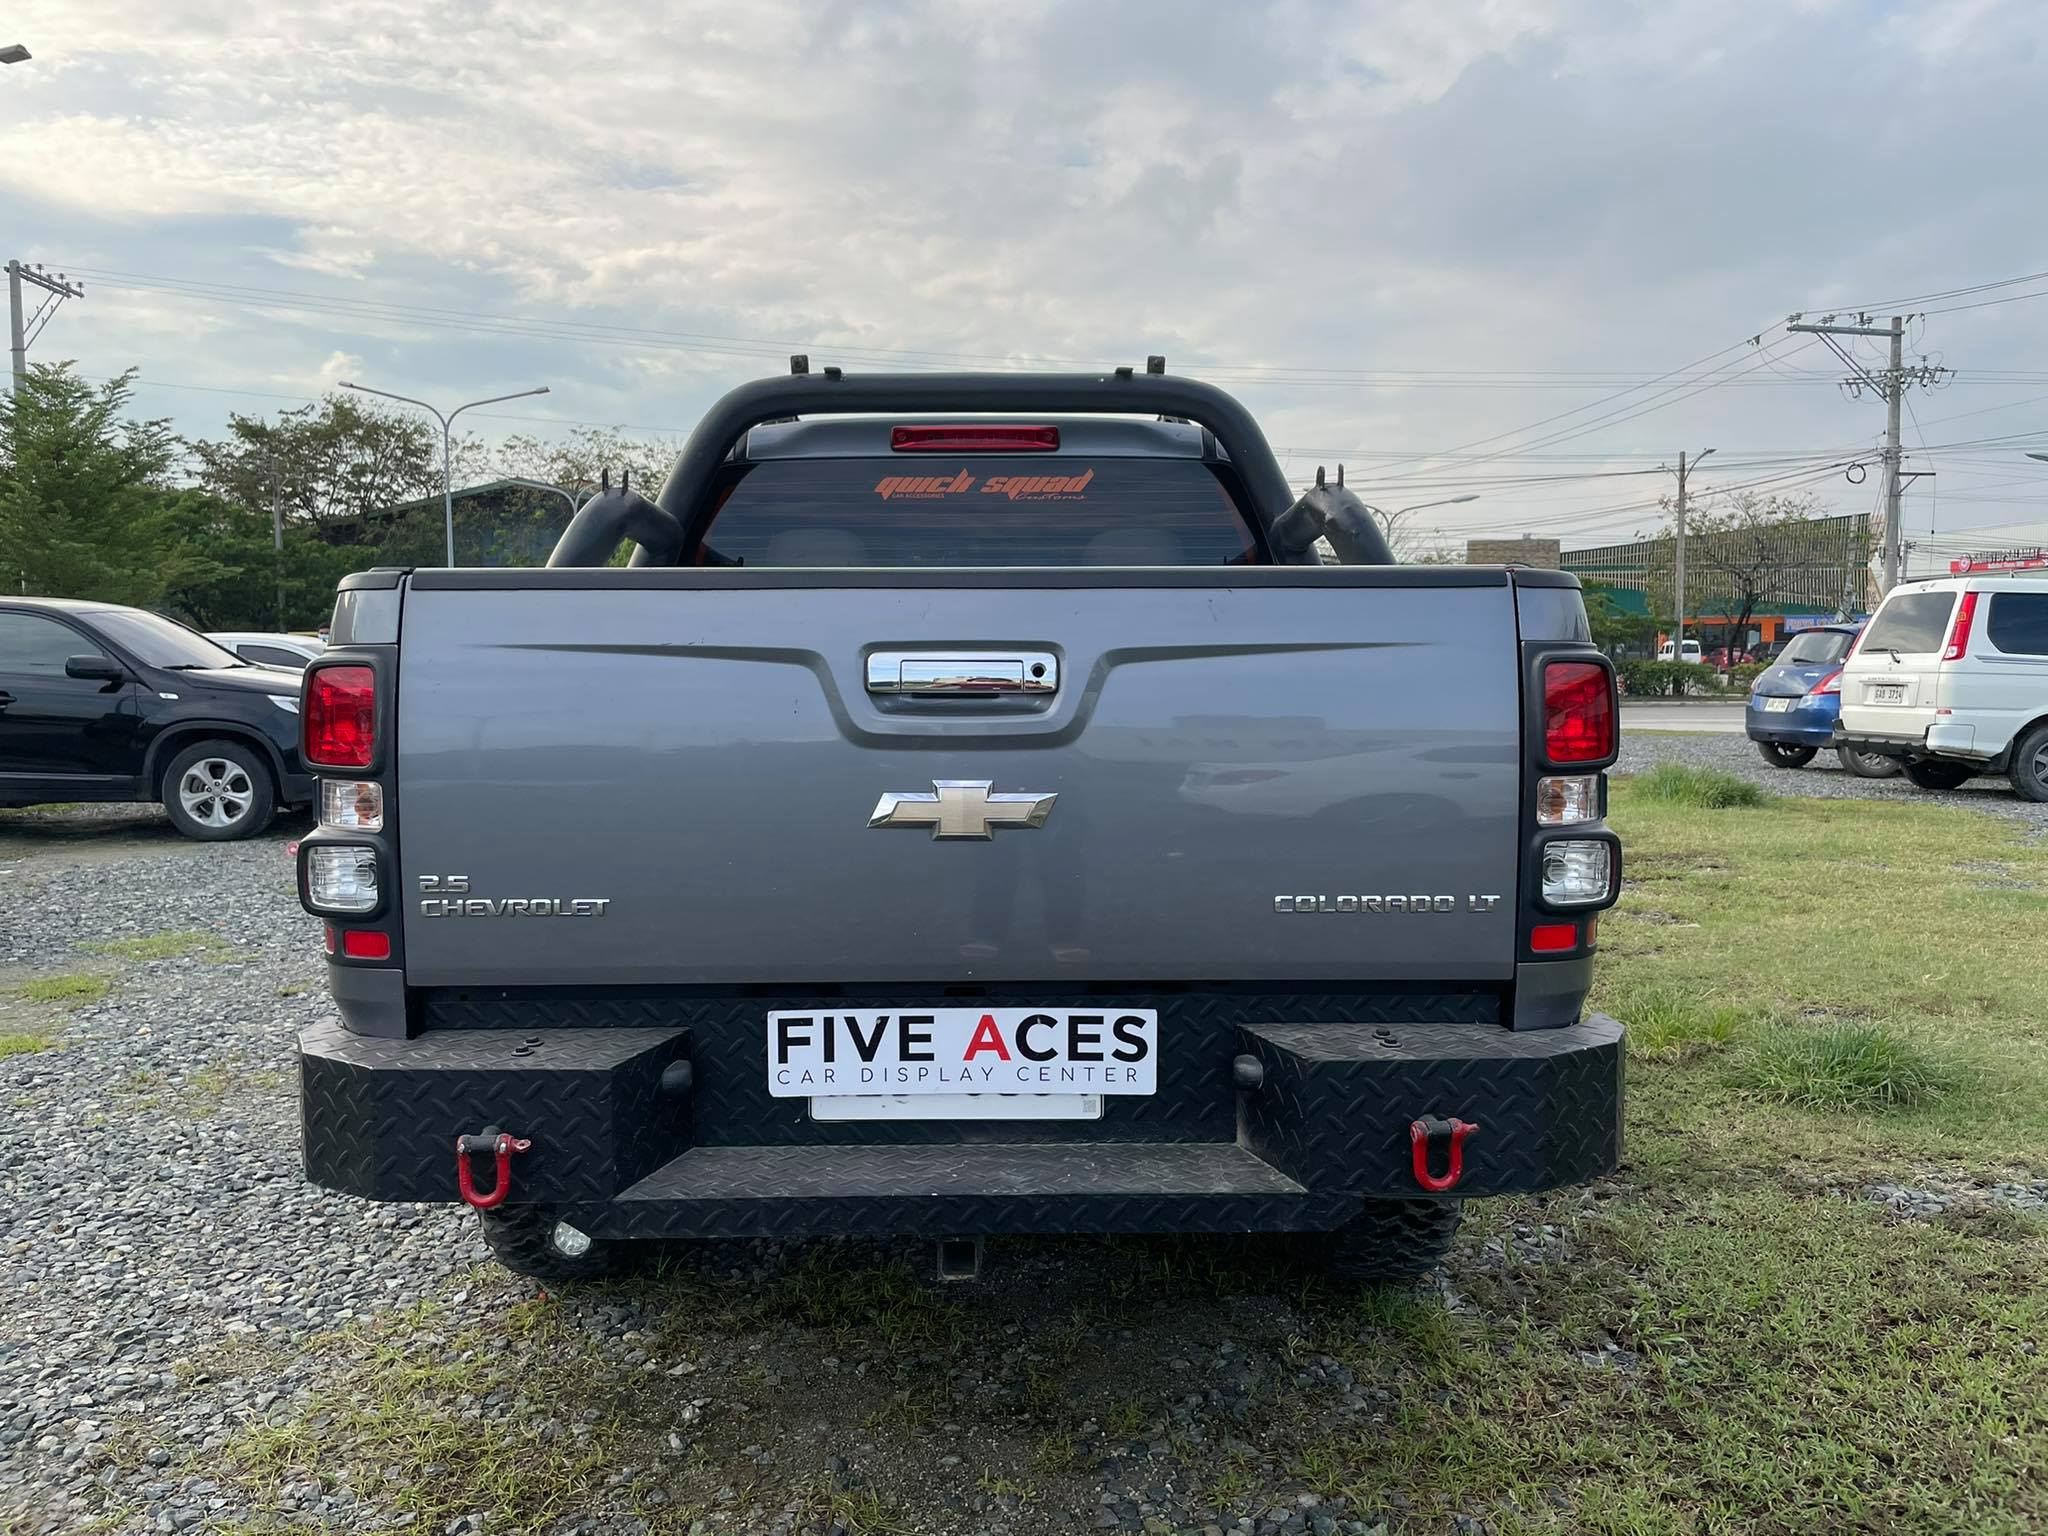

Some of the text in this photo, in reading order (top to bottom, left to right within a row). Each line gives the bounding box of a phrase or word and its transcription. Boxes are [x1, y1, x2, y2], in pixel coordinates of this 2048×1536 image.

[980, 468, 1094, 500] squad
[419, 875, 469, 893] 2.5
[420, 898, 610, 917] CHEVROLET
[1274, 895, 1501, 912] COLORADO LT
[777, 1014, 1149, 1064] FIVE ACES
[777, 1066, 1138, 1085] CAR DISPLAY CENTER
